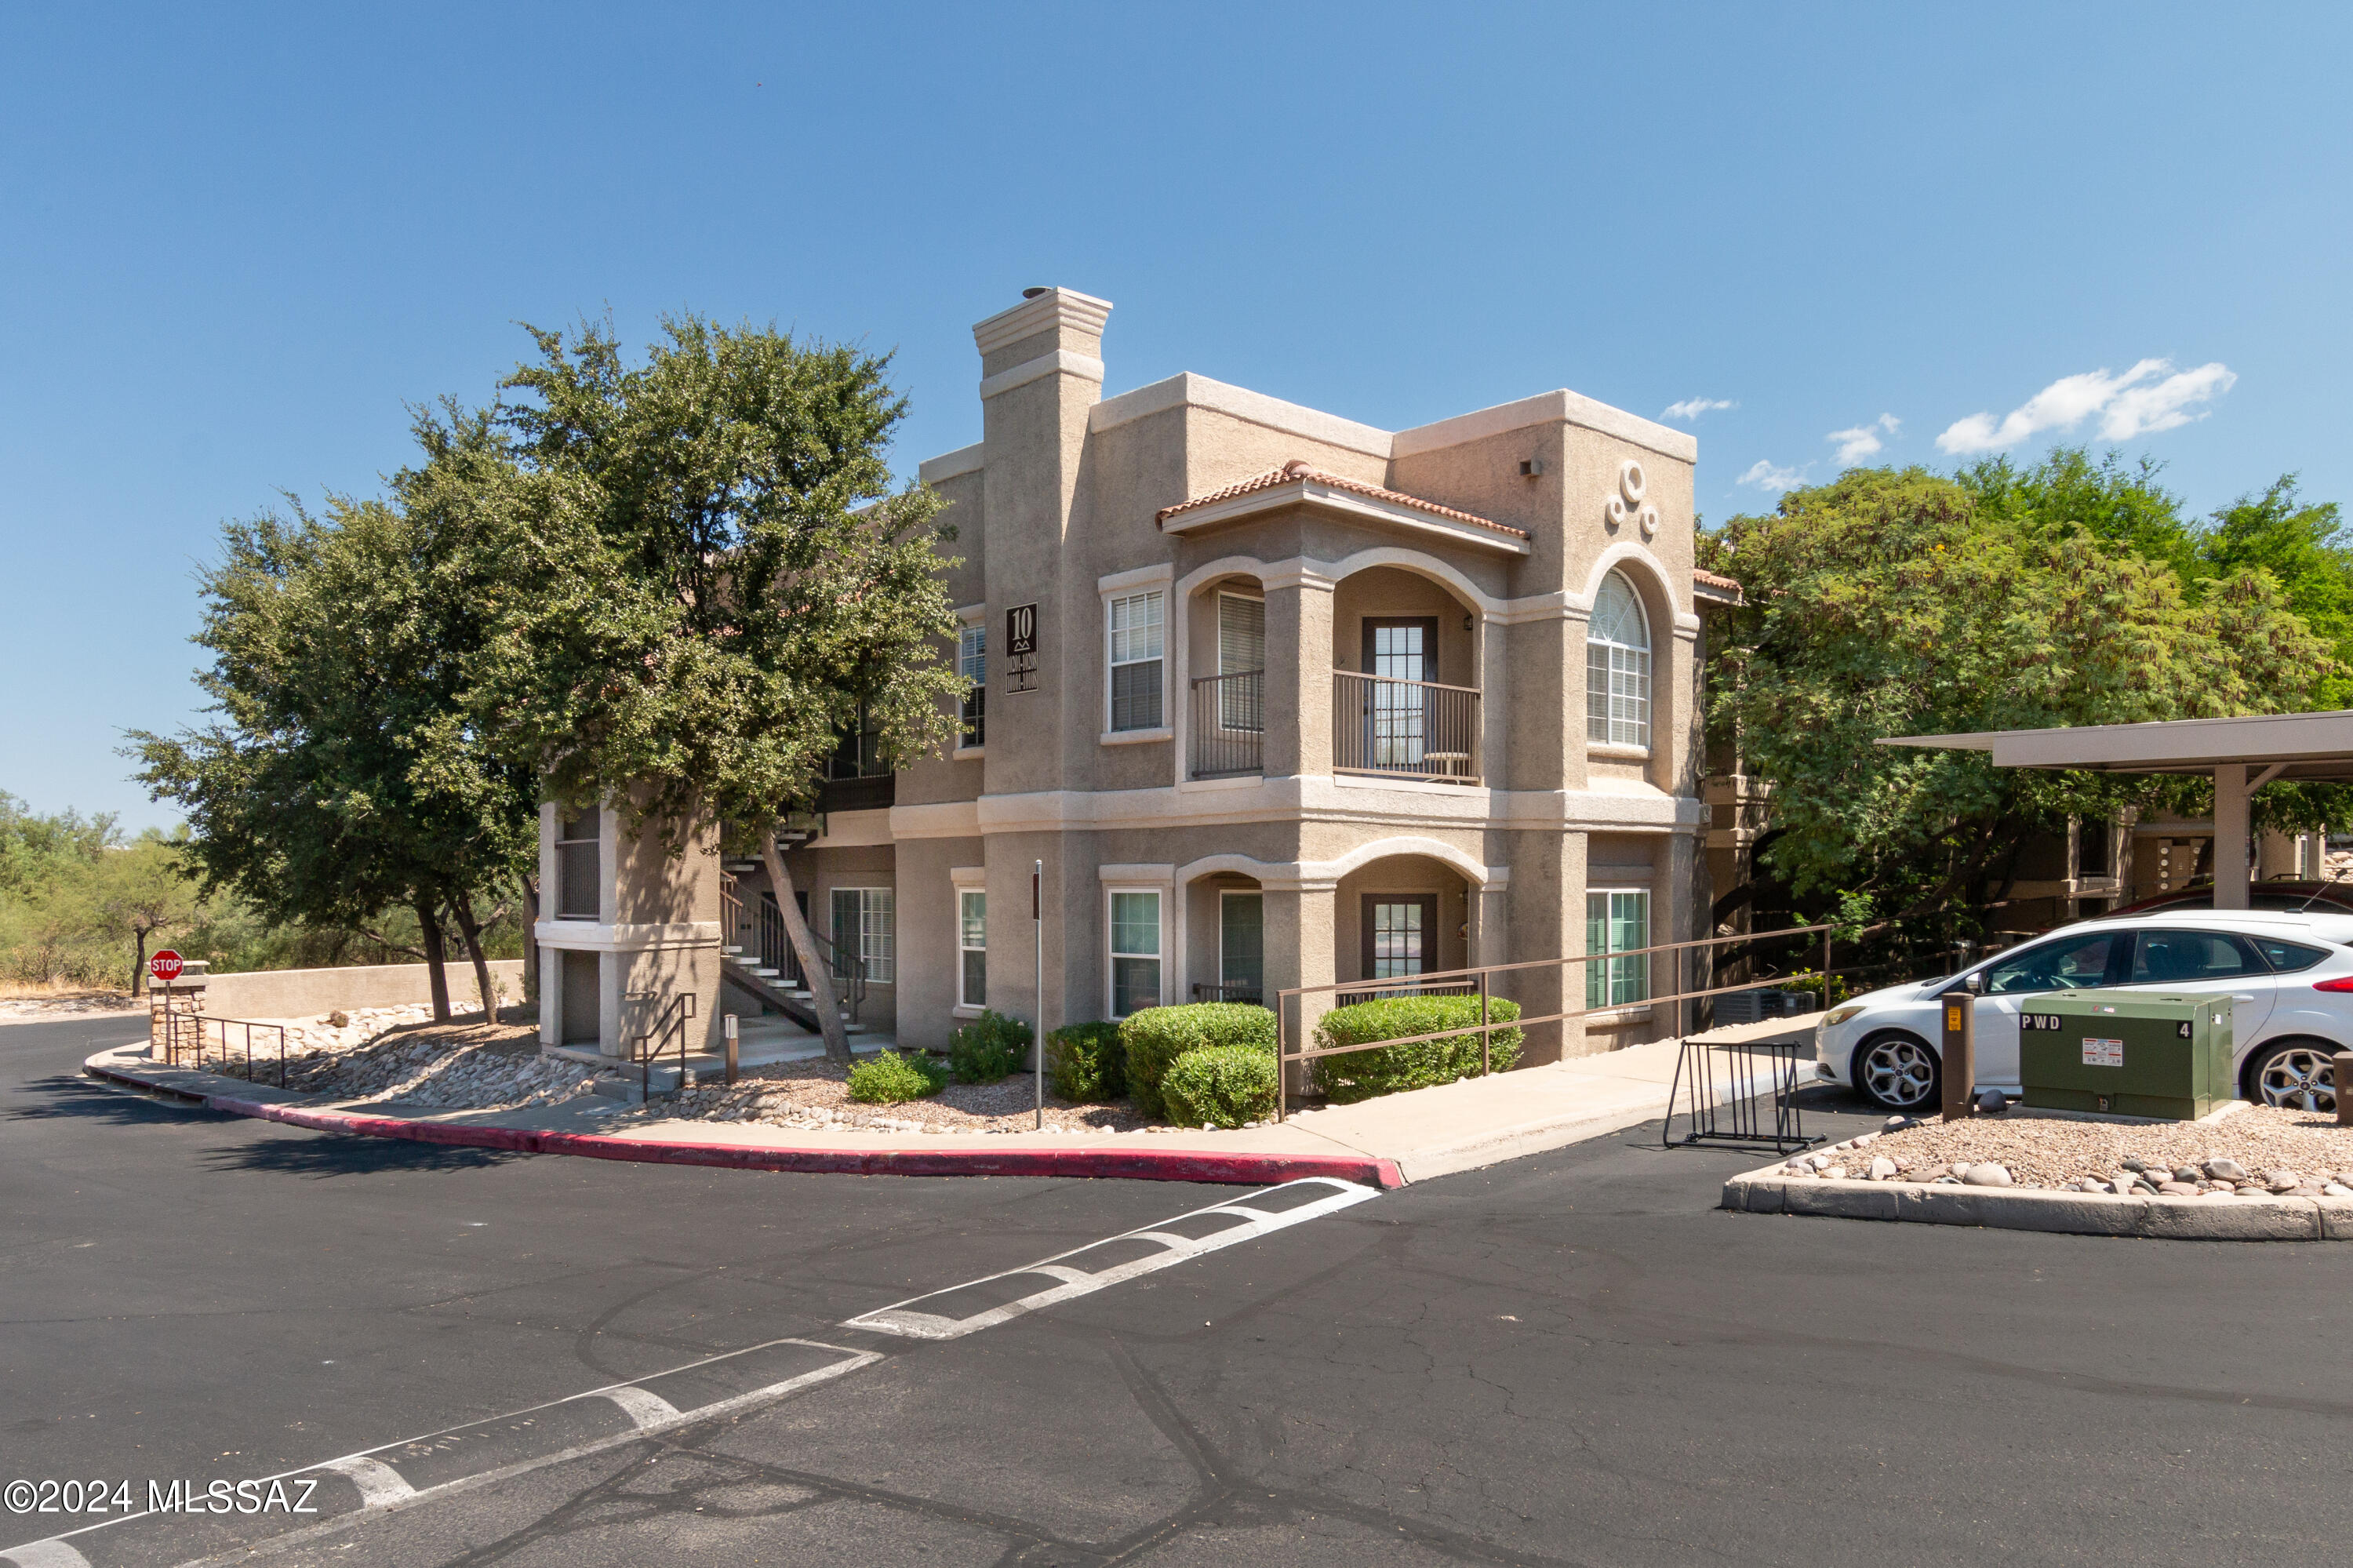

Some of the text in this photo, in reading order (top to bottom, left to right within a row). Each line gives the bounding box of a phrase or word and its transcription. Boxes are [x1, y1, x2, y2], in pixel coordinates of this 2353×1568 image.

[1012, 607, 1032, 640] 10
[152, 959, 181, 971] STOP
[2180, 1023, 2189, 1037] 4
